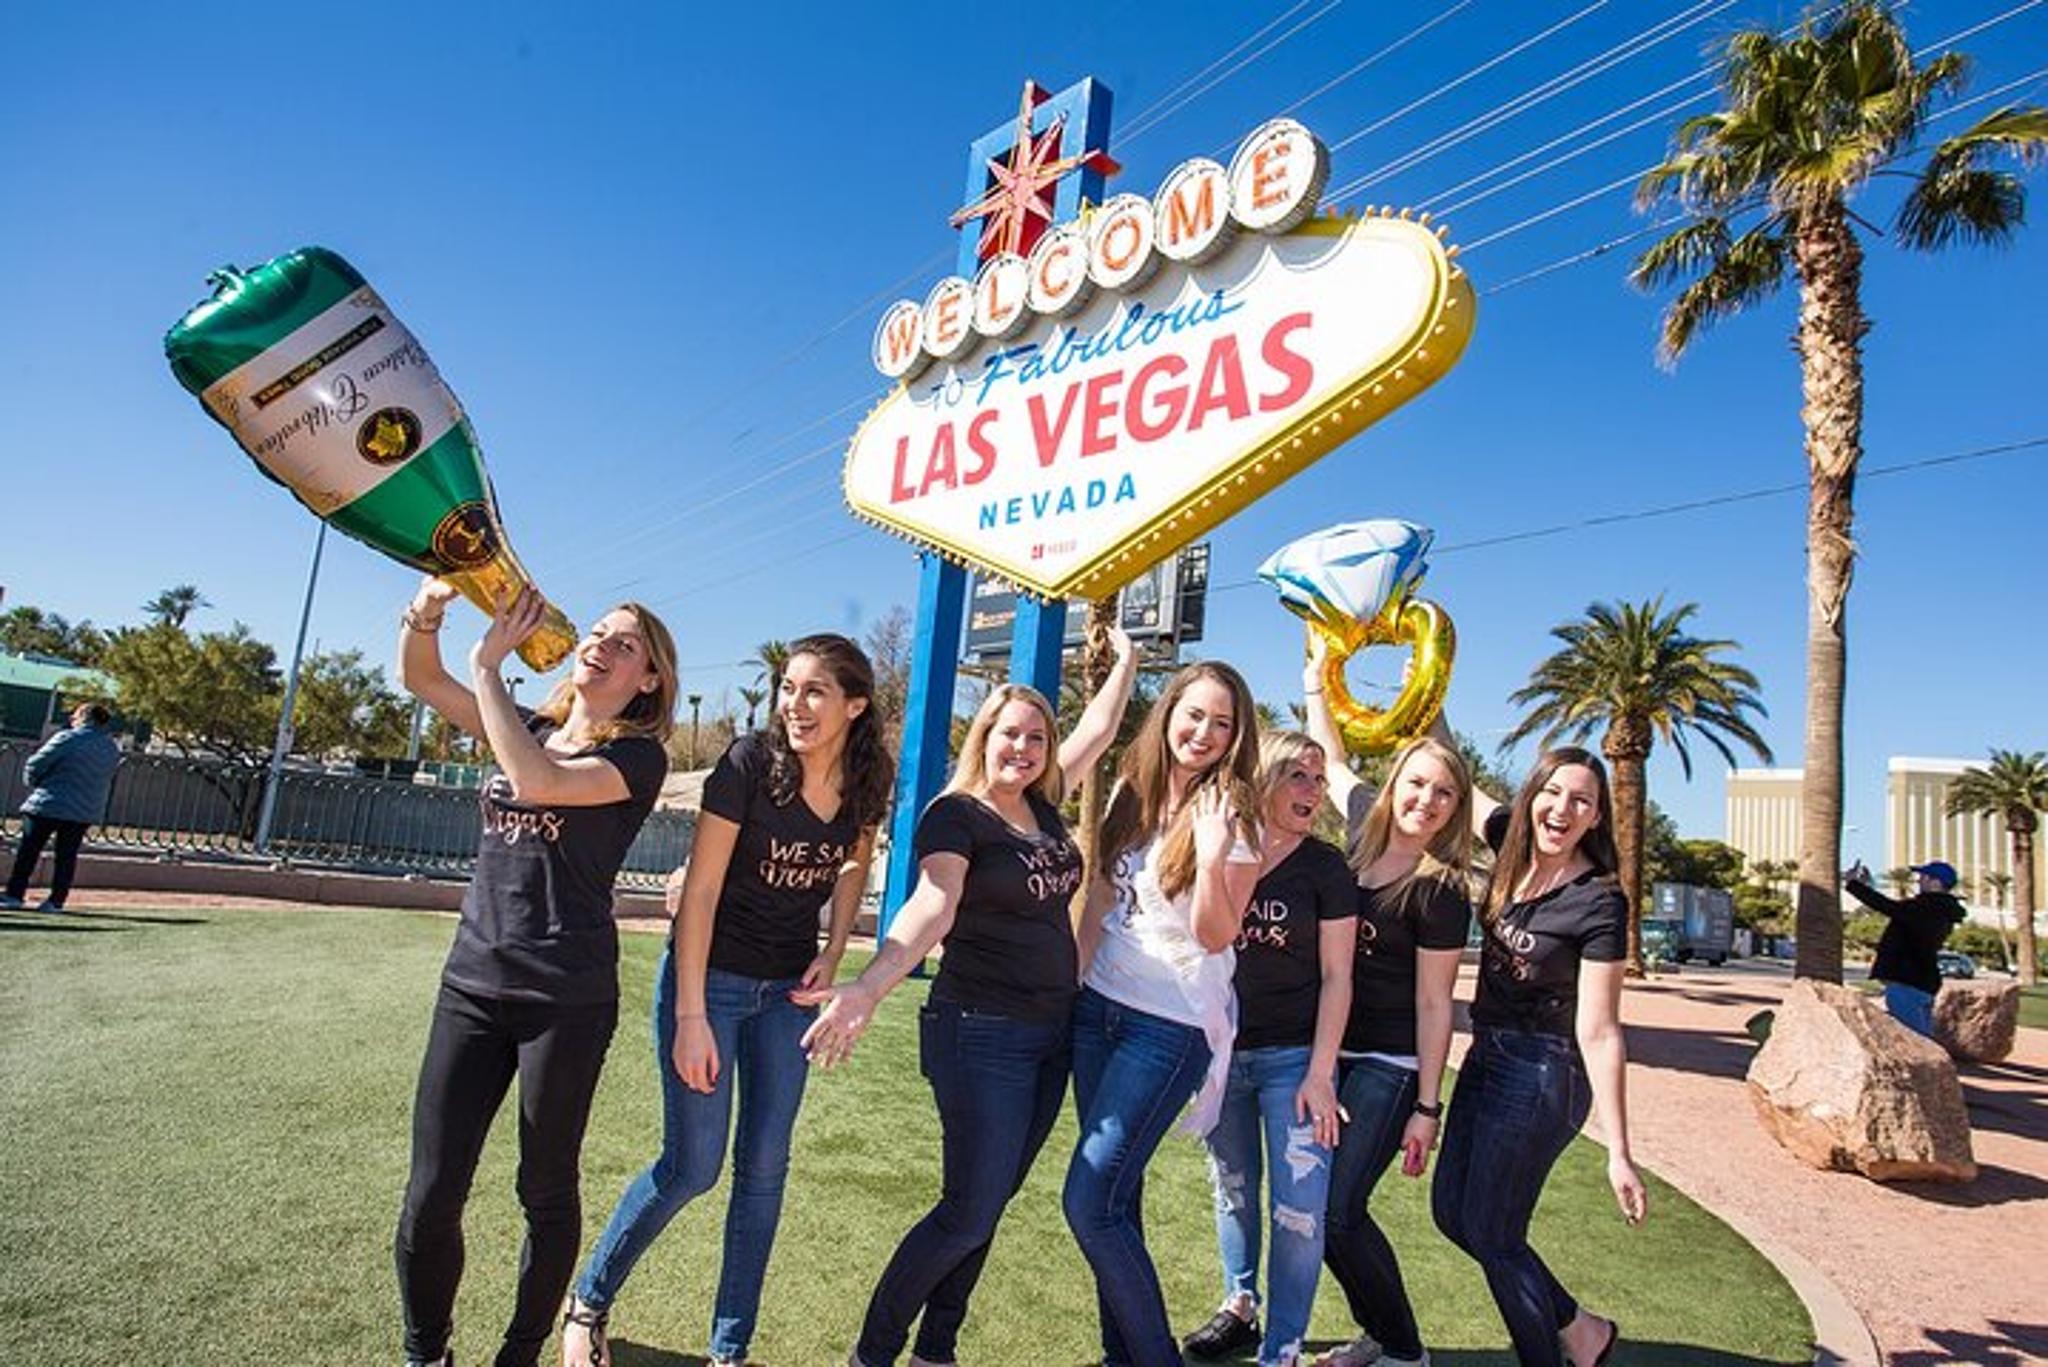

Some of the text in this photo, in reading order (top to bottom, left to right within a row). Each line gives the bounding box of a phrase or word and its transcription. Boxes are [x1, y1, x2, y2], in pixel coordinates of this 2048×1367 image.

[886, 140, 1294, 363] WELCOME
[976, 289, 1247, 405] Fabulous
[889, 312, 1315, 504] LAS VEGAS
[978, 471, 1137, 530] NEVADA
[771, 838, 845, 864] WE SA
[1244, 899, 1289, 922] AID
